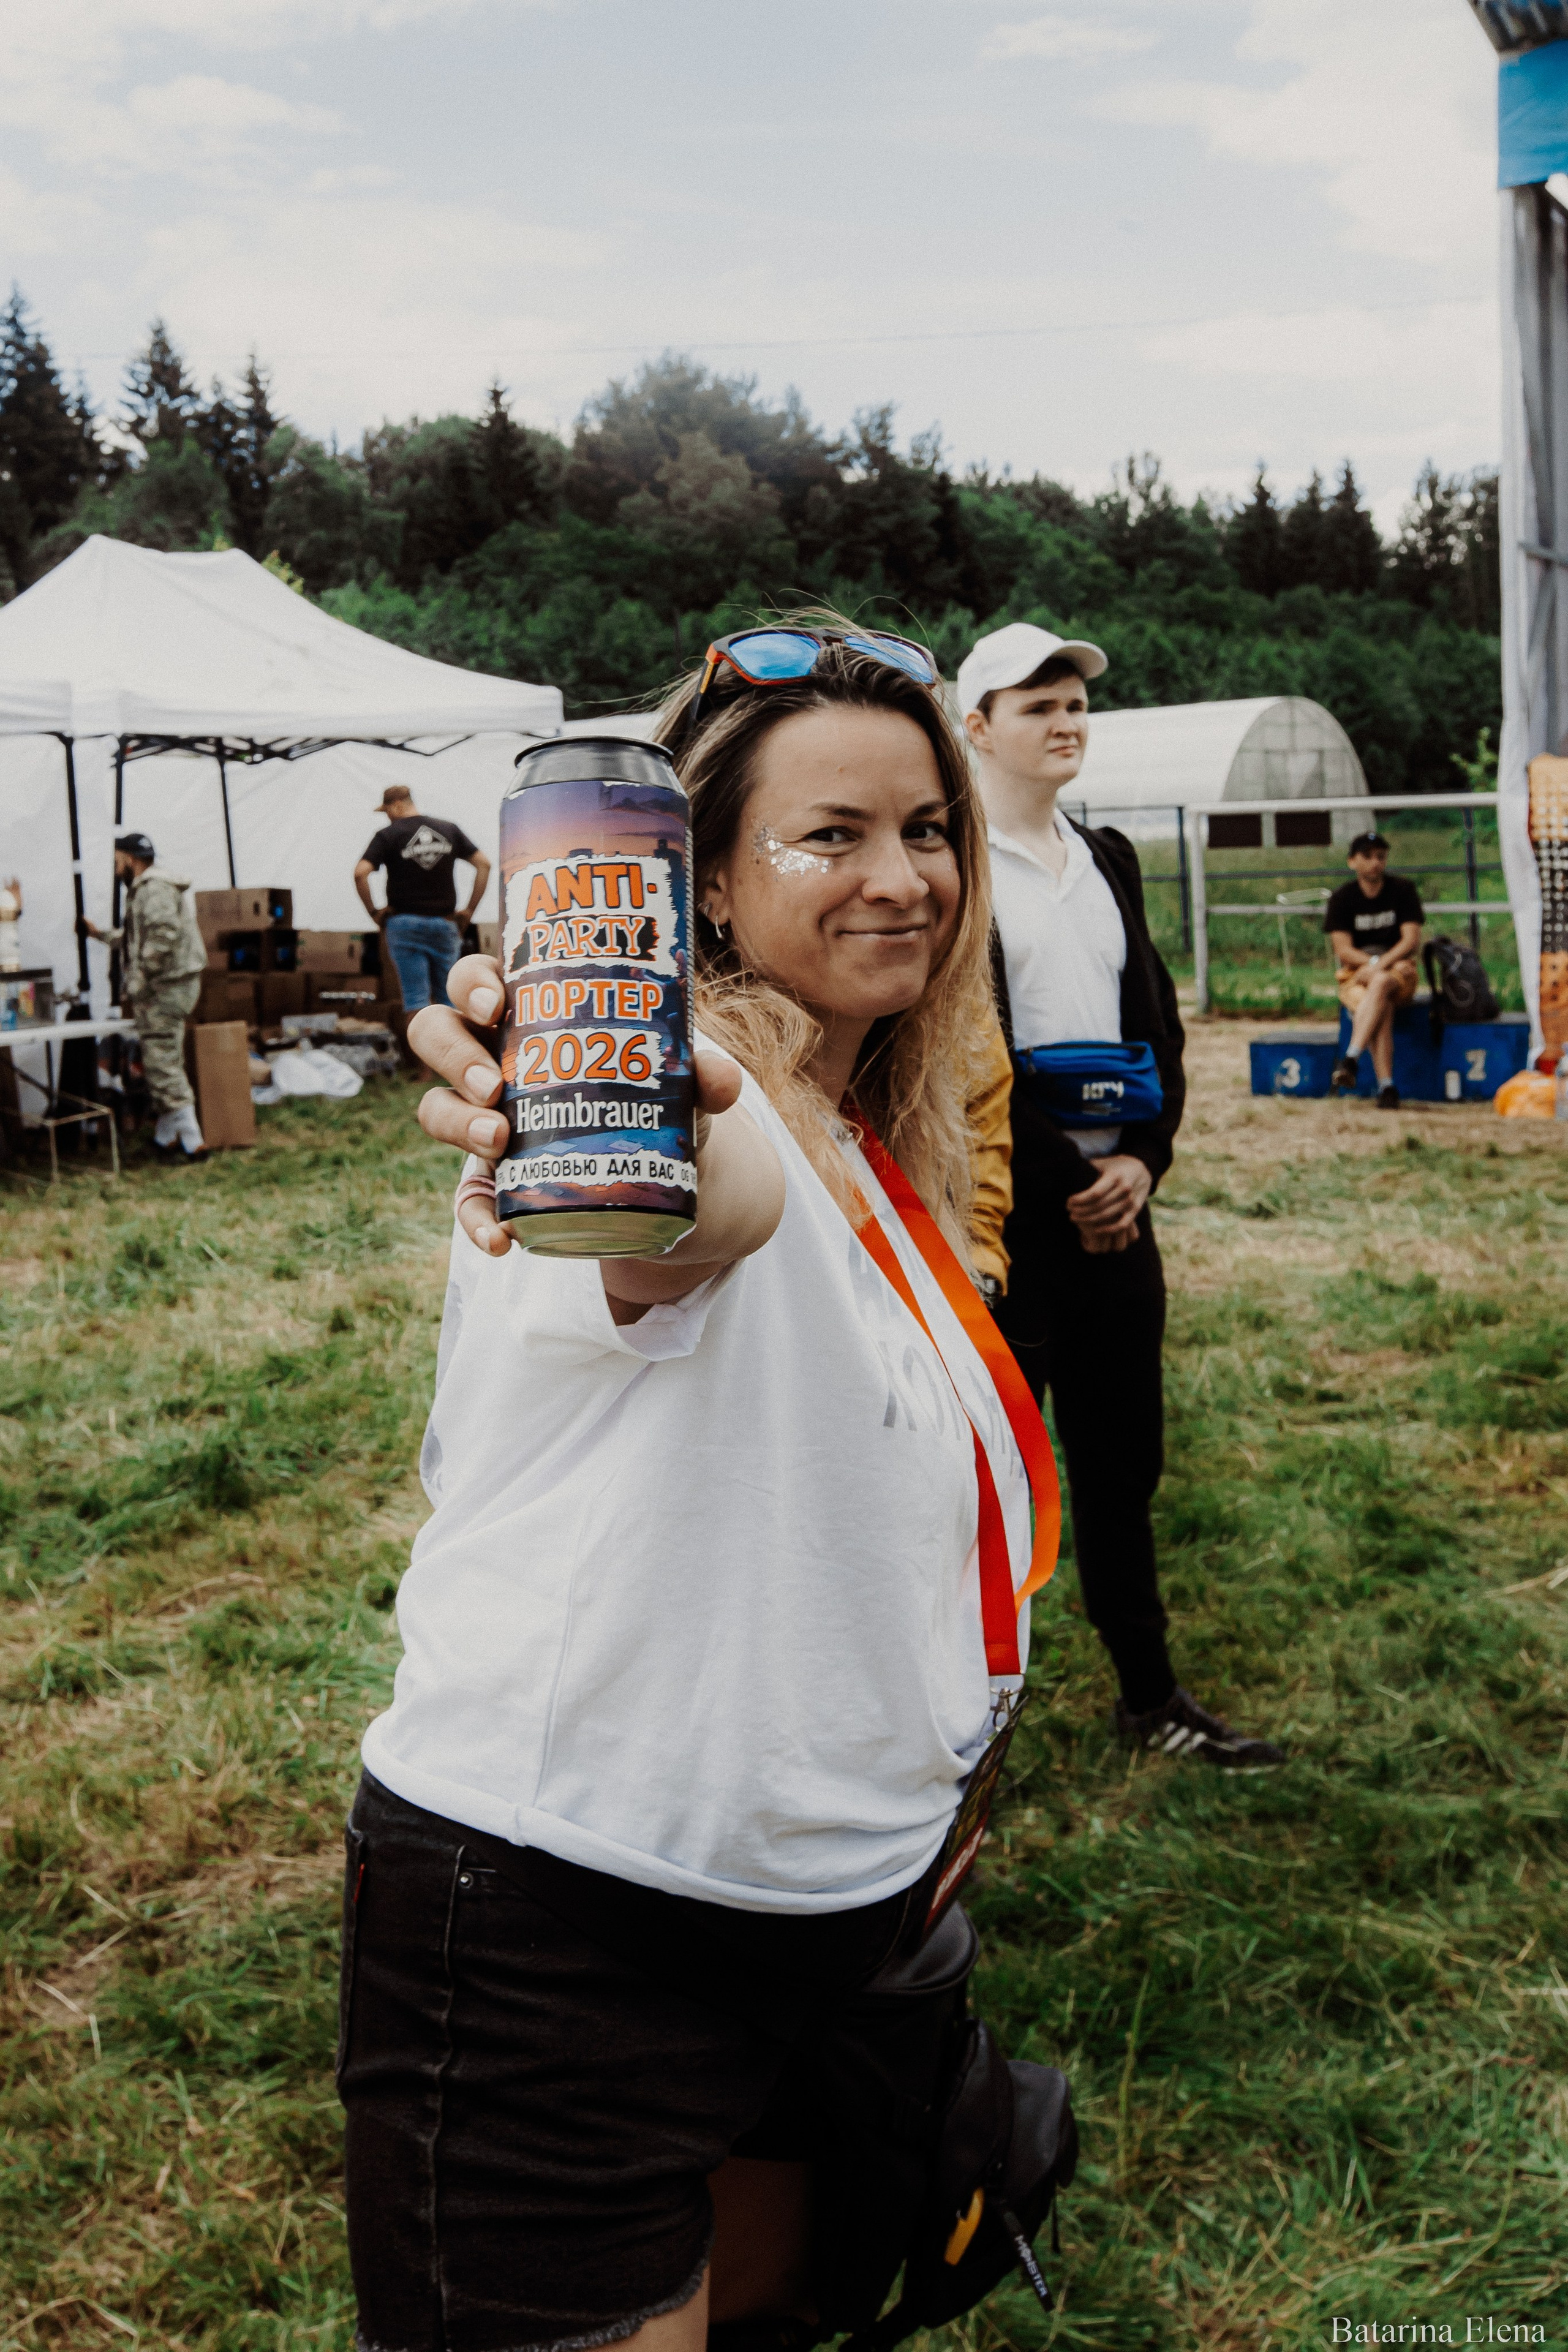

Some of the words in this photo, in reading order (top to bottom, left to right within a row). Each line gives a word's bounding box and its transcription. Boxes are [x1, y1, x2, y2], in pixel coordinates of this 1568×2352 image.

[525, 862, 657, 922] ANTI-
[529, 916, 645, 964] PARTY
[516, 979, 663, 1027] ПОРТЕР
[524, 1031, 651, 1085] 2026
[1281, 1058, 1301, 1088] 3
[516, 1093, 664, 1133] Heimbrauer
[510, 1166, 516, 1182] С
[521, 1159, 597, 1180] ЛЮБОВЬЮ
[607, 1158, 641, 1176] ДЛЯ
[649, 1161, 674, 1180] ВАС
